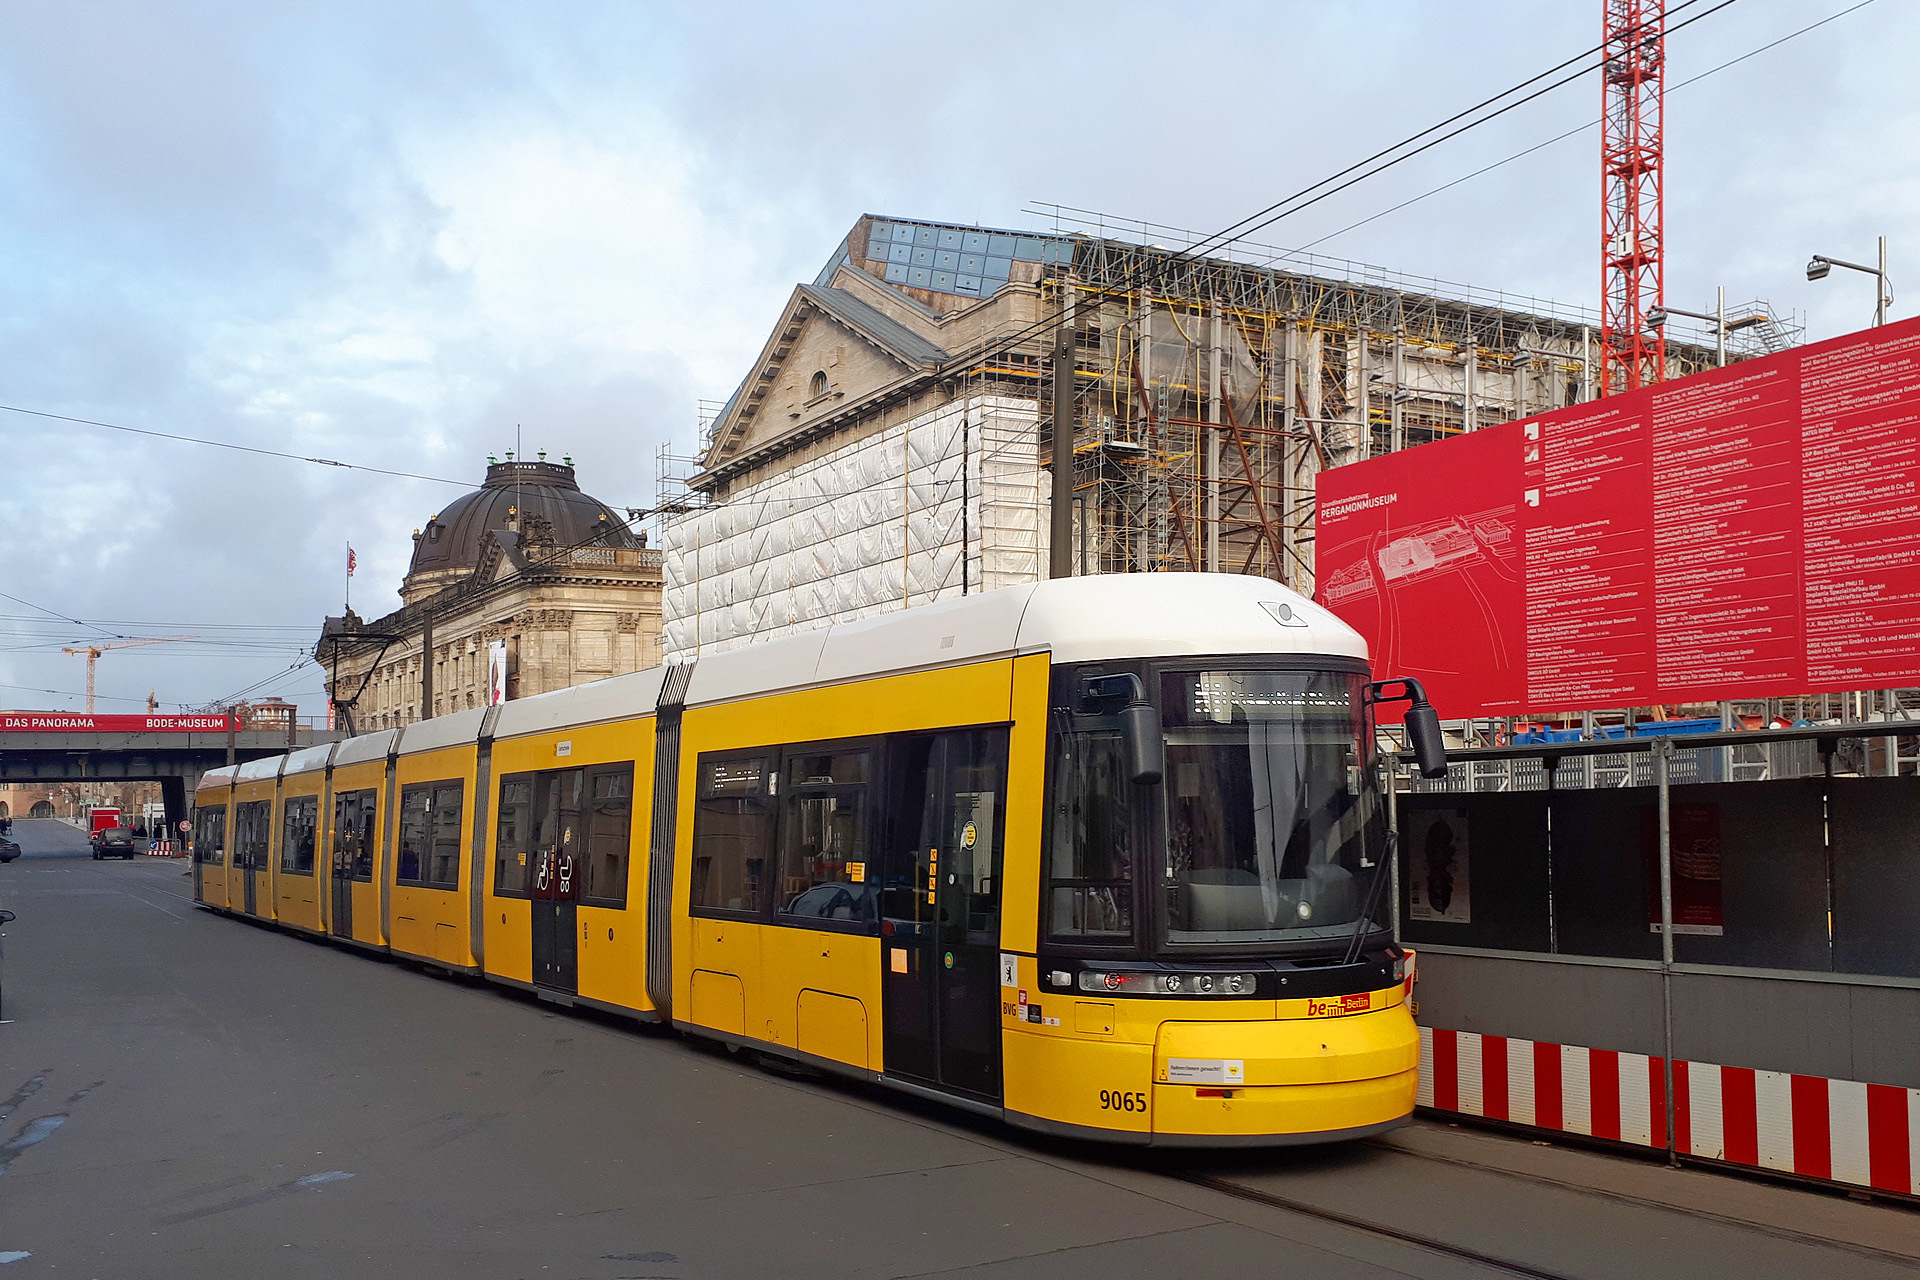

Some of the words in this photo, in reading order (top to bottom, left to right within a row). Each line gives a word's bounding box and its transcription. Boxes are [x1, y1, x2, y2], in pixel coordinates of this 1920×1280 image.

[1321, 493, 1397, 519] PERGAMONMUSEUM
[6, 718, 28, 727] DAS
[32, 718, 94, 727] PANORAMA
[146, 718, 223, 728] BODE-MUSEUM
[1003, 1002, 1016, 1016] BVG
[1308, 998, 1326, 1016] be
[1346, 998, 1368, 1008] Berlin
[1100, 1090, 1146, 1112] 9065
